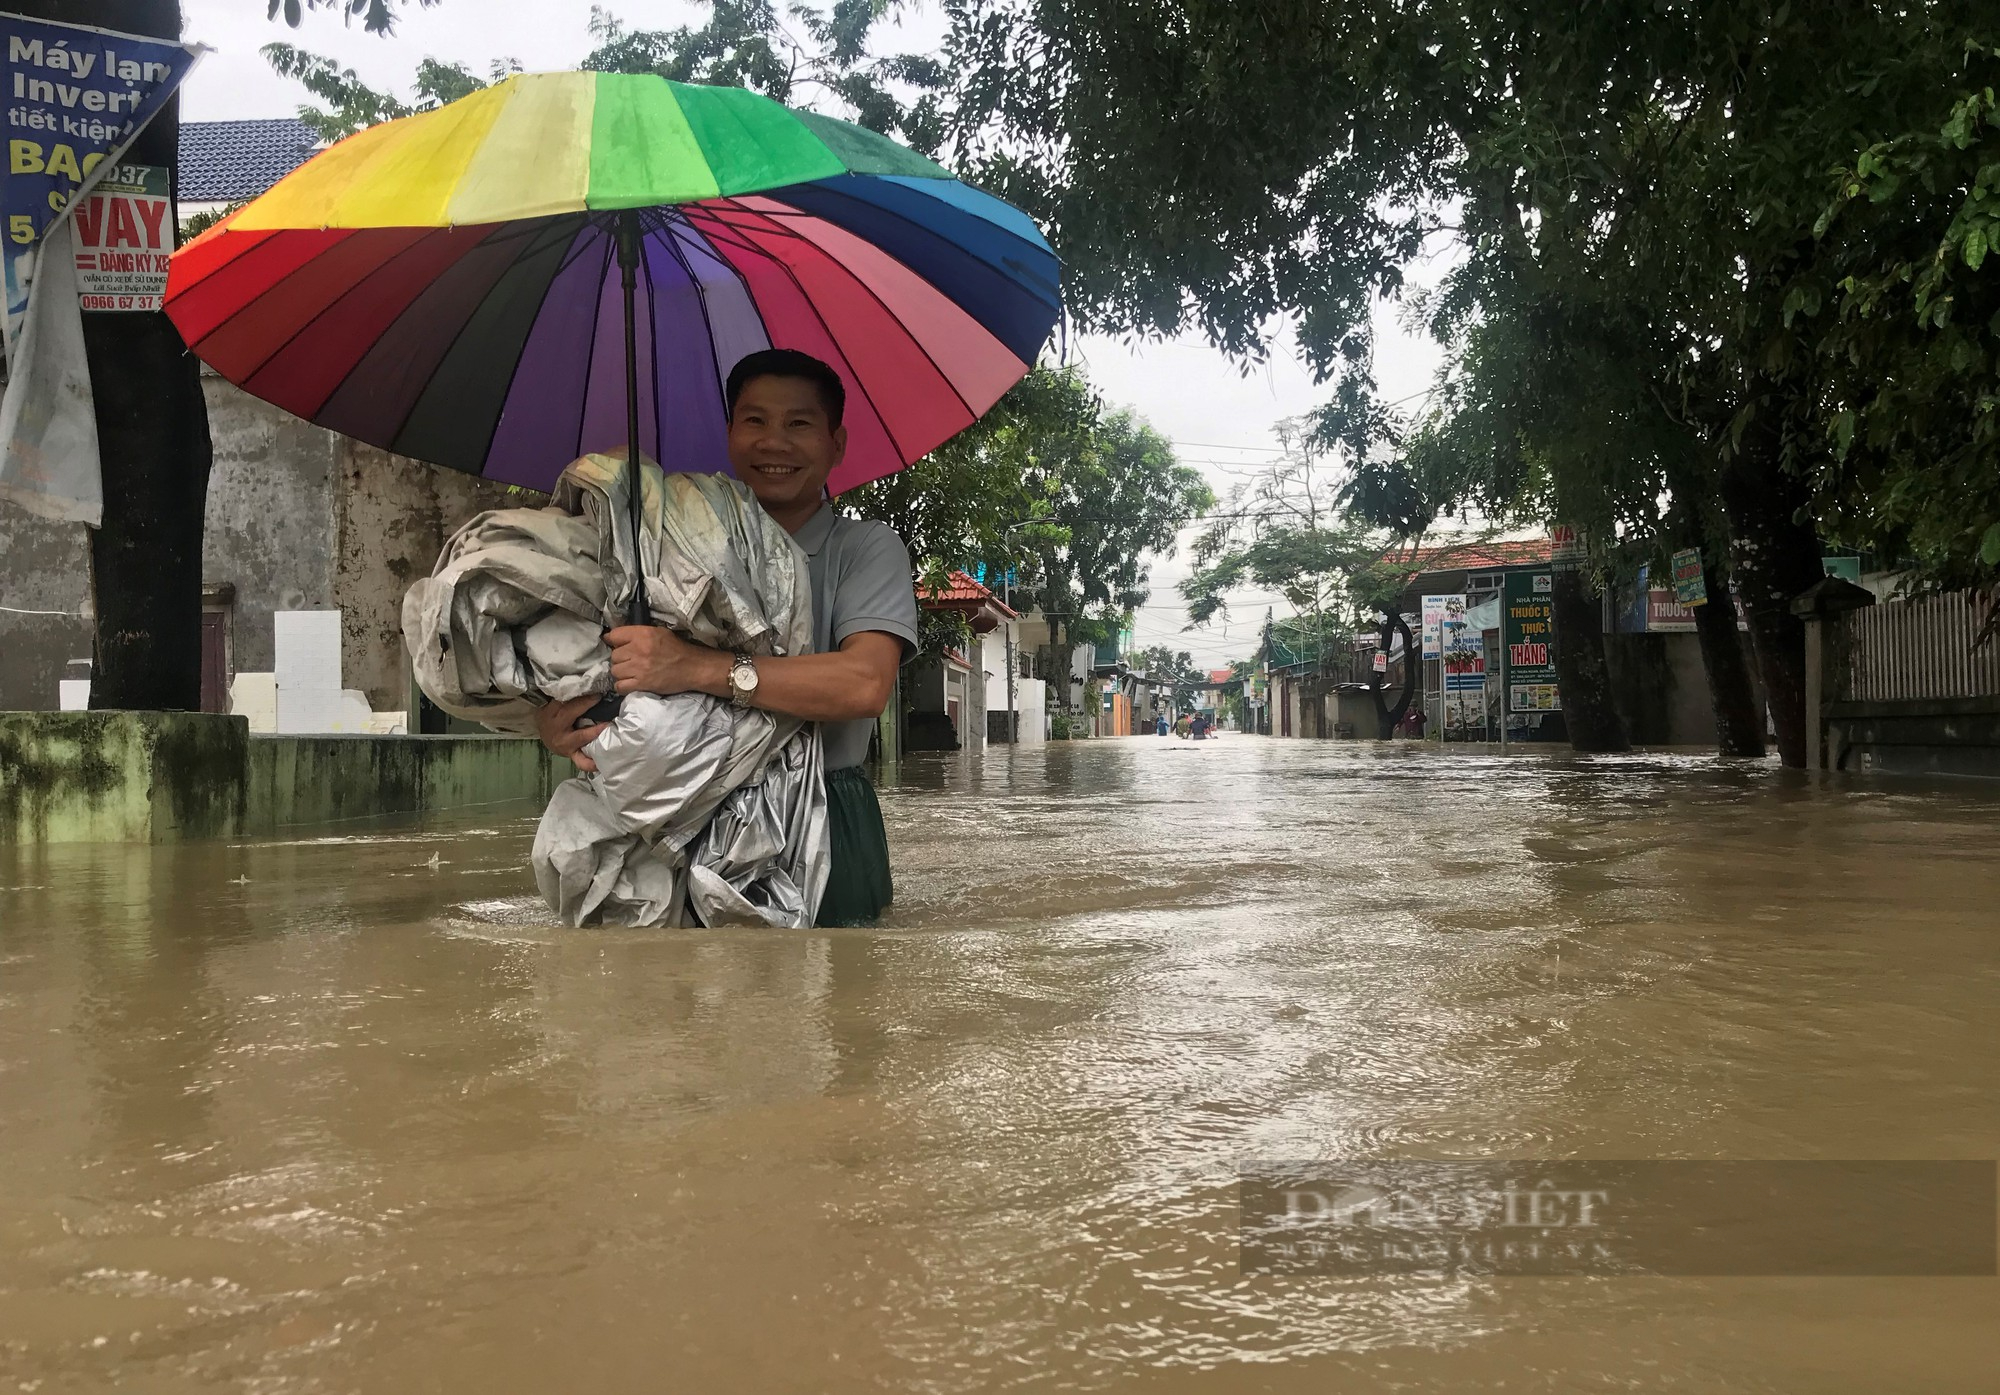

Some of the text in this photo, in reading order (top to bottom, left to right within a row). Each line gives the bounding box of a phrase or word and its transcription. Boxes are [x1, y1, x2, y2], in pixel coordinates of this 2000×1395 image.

[9, 35, 96, 79] Máy
[8, 106, 57, 131] tiết
[9, 215, 36, 244] 5
[74, 196, 167, 249] VAY
[99, 249, 134, 272] ĐĂNG
[135, 250, 152, 272] KÝ
[82, 296, 115, 309] 0966
[118, 296, 134, 309] 67
[138, 296, 154, 309] 37
[1510, 603, 1541, 618] THUỐC
[1521, 621, 1546, 636] THỰC
[1509, 636, 1548, 667] THẮNG
